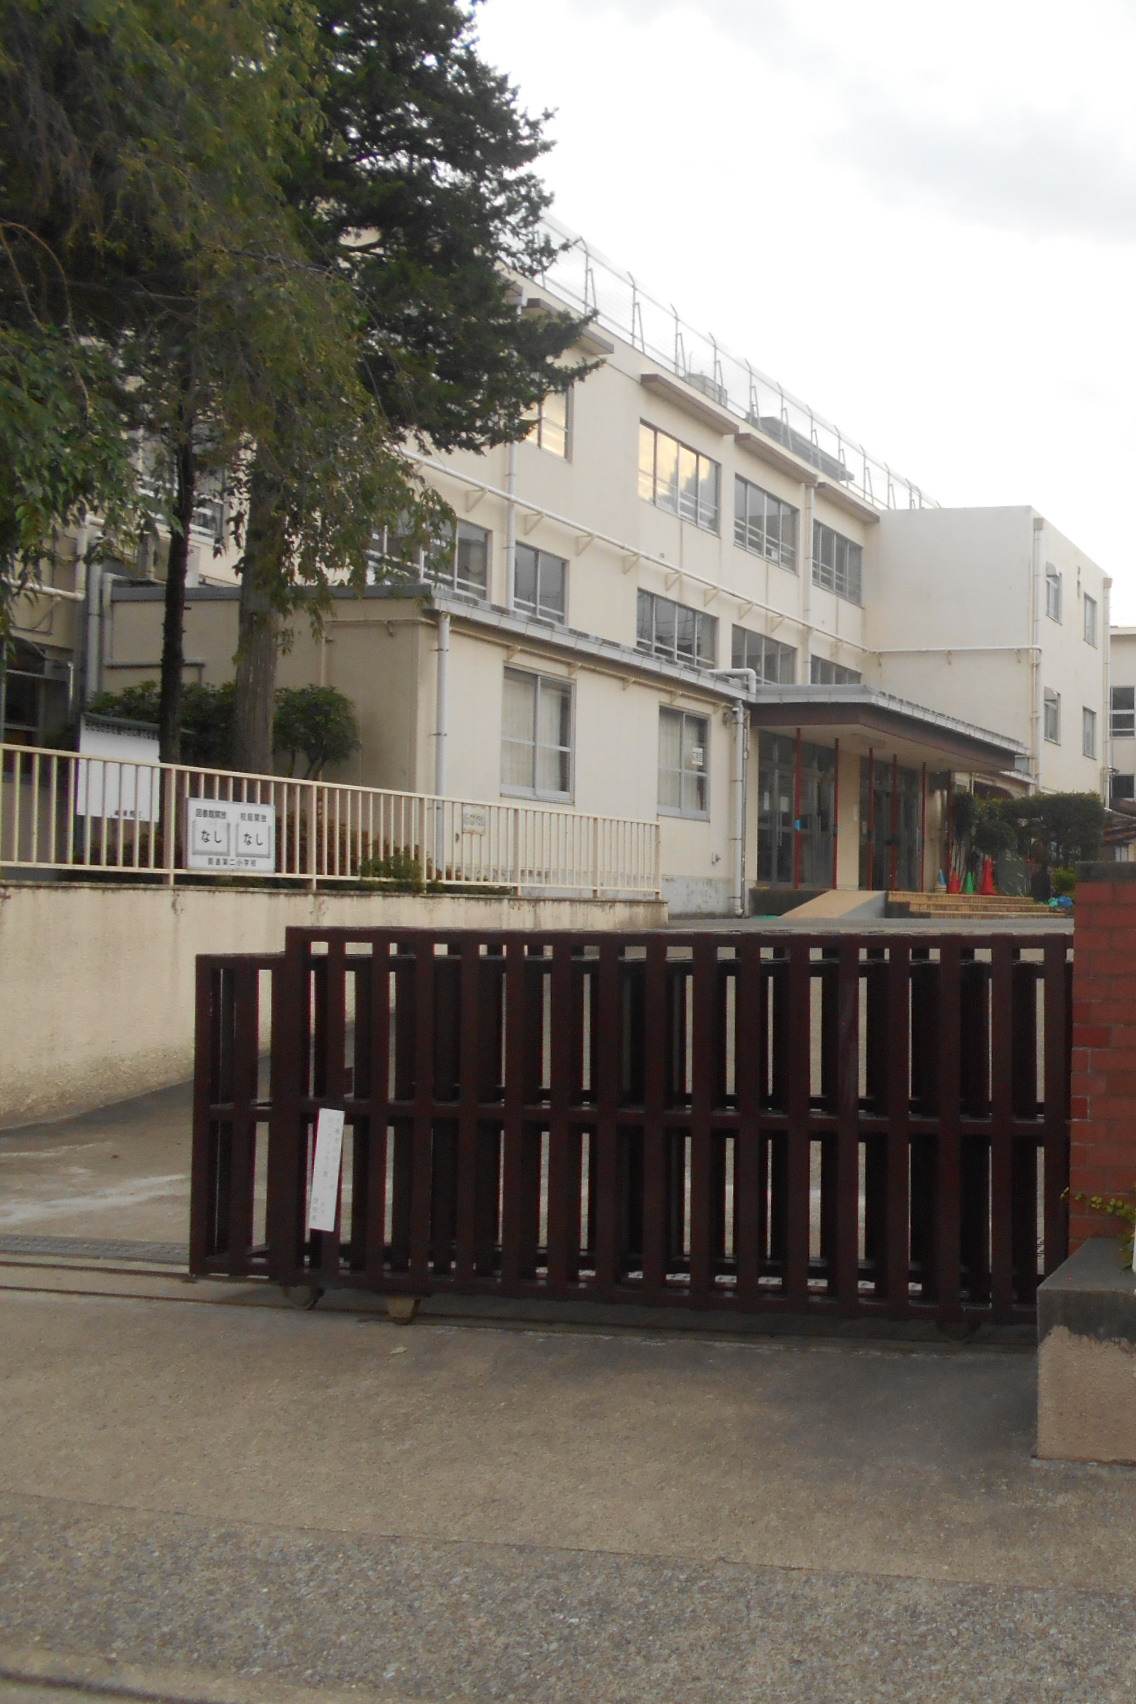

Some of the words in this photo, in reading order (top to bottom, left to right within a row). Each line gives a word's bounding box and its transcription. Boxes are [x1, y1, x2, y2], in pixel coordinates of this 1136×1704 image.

[240, 812, 267, 823] 校庭開放
[201, 829, 222, 843] なし
[243, 833, 263, 846] なし
[208, 857, 257, 867] 開進第二小学校
